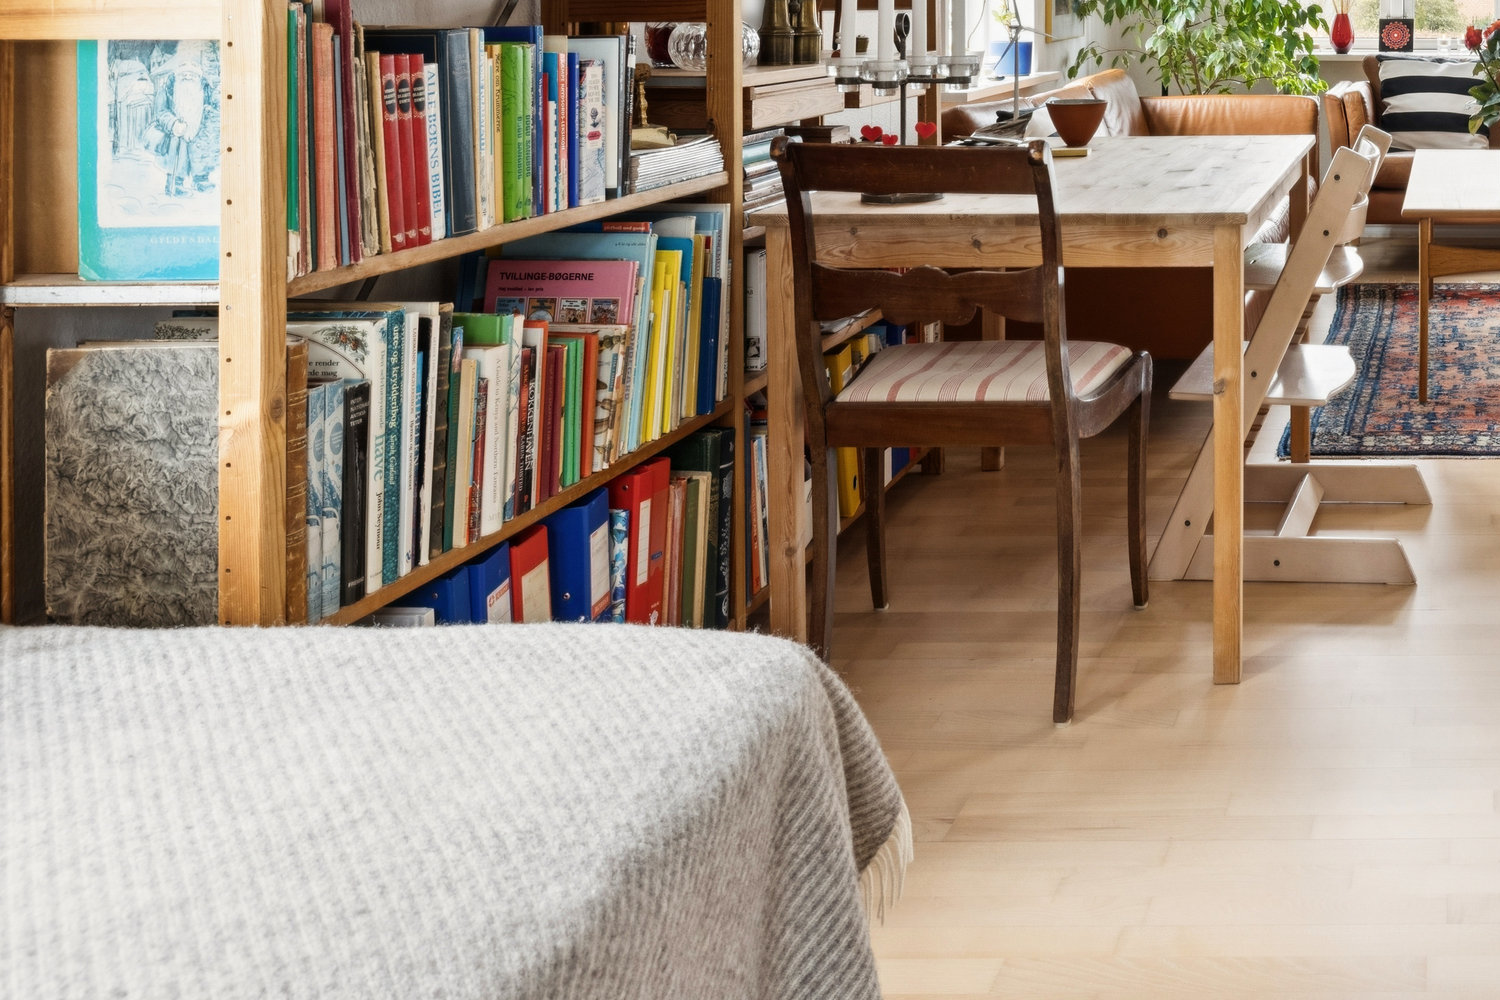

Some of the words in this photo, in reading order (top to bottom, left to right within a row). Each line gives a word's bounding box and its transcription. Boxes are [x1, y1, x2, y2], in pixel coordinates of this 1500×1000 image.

[427, 71, 437, 109] ALLE
[428, 114, 439, 169] BØRNS
[431, 173, 442, 219] BIBEL
[500, 272, 594, 282] TVILLINGE-BØGERNE
[315, 359, 340, 367] render
[390, 350, 399, 363] og
[389, 366, 400, 428] krydderibog
[373, 433, 385, 482] have
[375, 492, 383, 511] John
[374, 513, 382, 550] Seymour
